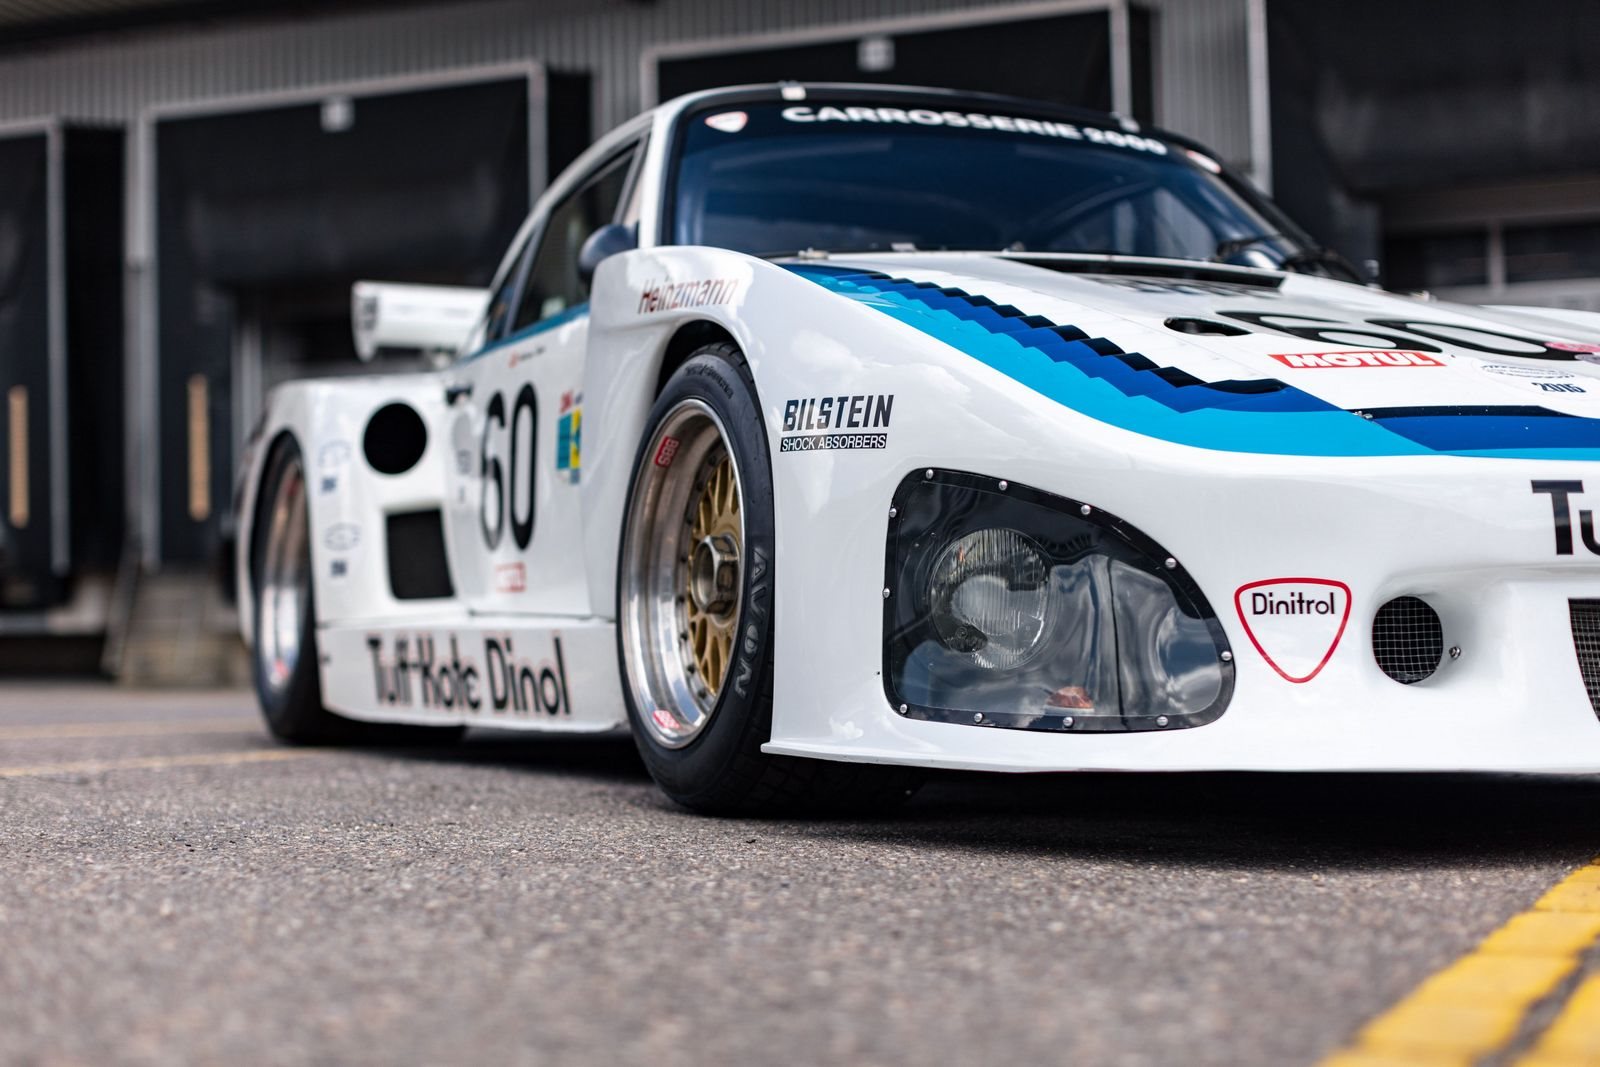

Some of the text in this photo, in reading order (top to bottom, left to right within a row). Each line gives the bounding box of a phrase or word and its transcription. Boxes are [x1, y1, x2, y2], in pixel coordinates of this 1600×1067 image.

[782, 106, 1083, 141] CARROSSERIE
[1082, 127, 1167, 155] 2000
[637, 277, 738, 314] Heinzmann
[1216, 310, 1588, 362] 60
[1283, 352, 1428, 367] MOTUL
[782, 394, 895, 432] BILSTEIN
[781, 433, 887, 453] SHOCK ABSORBERS
[480, 382, 539, 553] 60
[734, 547, 768, 699] AVON
[1251, 591, 1335, 616] Dinitrol
[365, 634, 571, 716] Tuff-Kote Dinol
